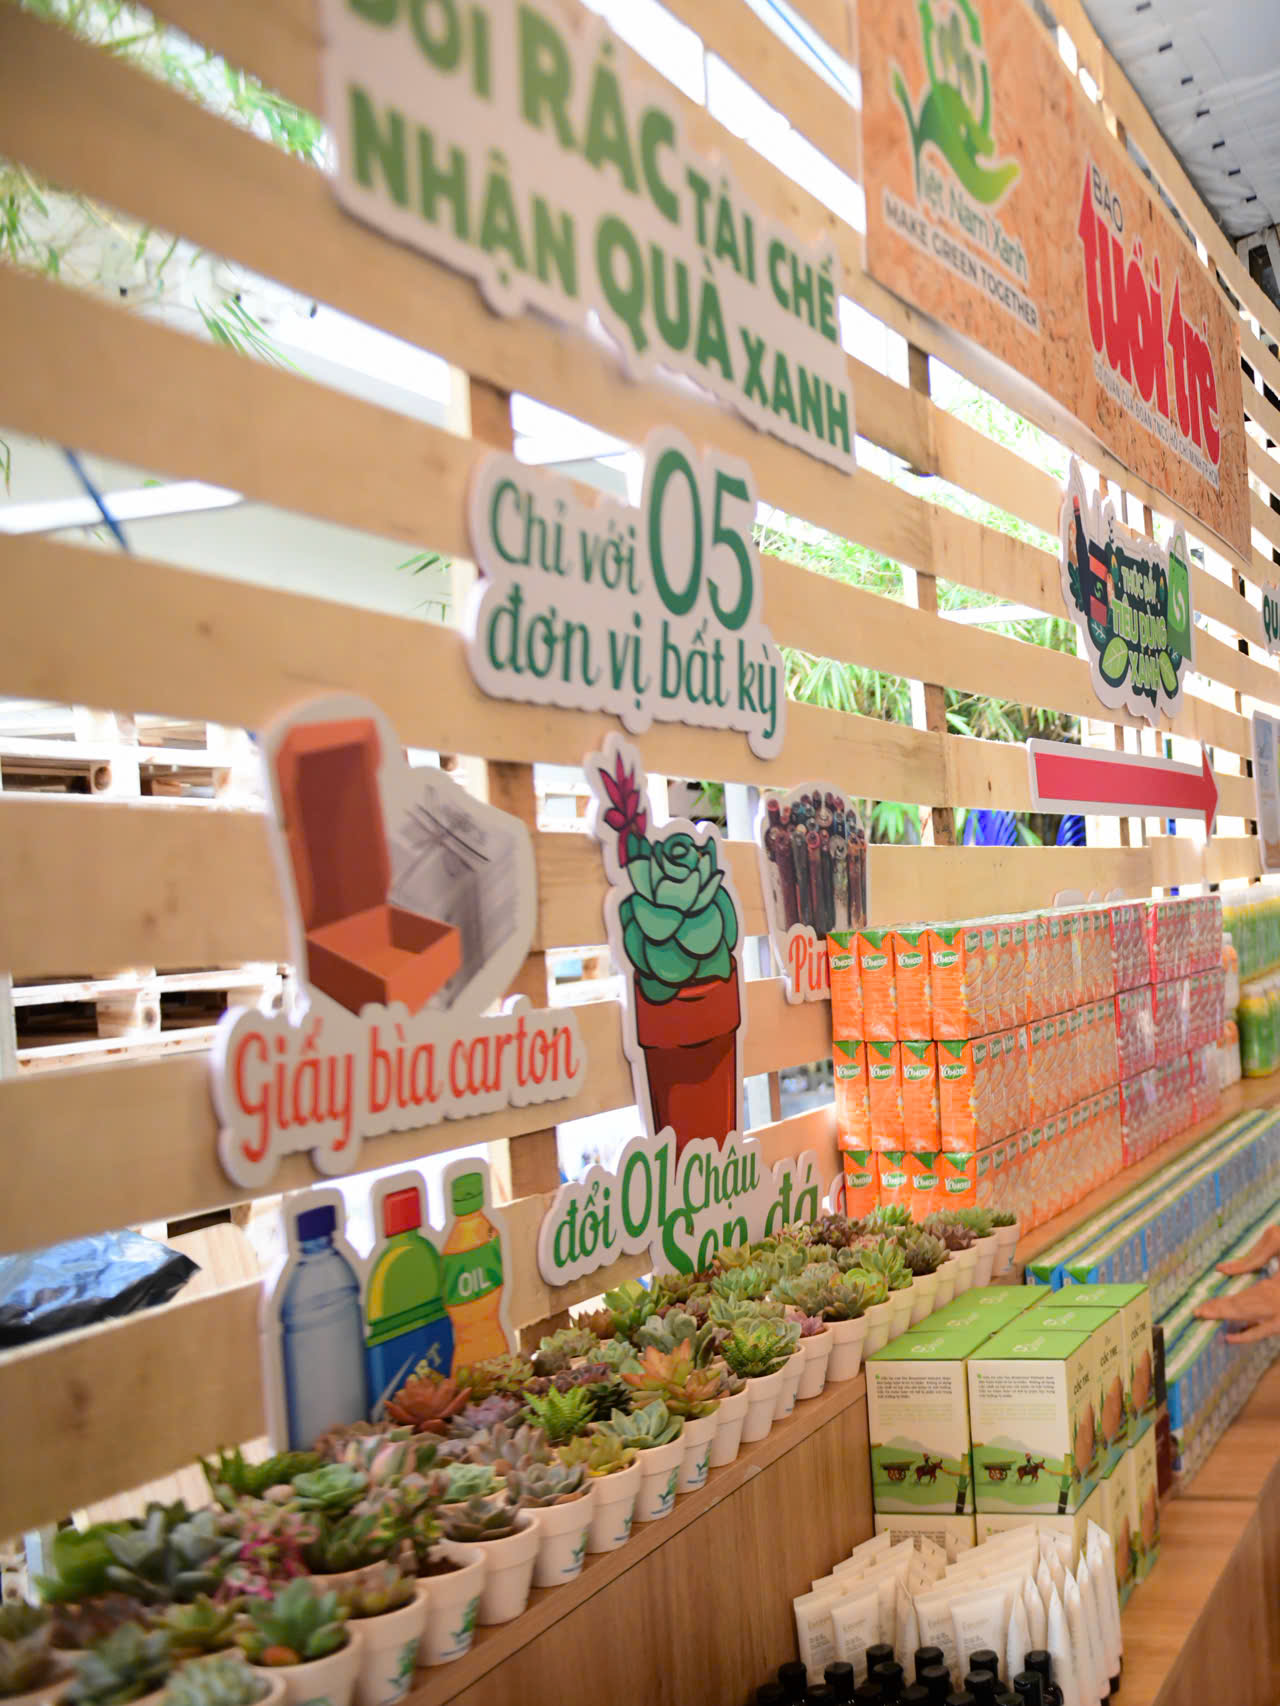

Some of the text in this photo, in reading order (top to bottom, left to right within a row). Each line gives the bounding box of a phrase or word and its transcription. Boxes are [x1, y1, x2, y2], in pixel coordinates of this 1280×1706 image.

[517, 5, 683, 224] RÁC
[687, 165, 756, 285] TÁI
[768, 252, 838, 342] CHẾ
[347, 85, 851, 455] NHẬN QUÀ XANH
[490, 448, 754, 631] Chỉ với 05
[487, 581, 777, 740] đơn vị bất kỳ
[234, 1015, 579, 1163] Giấy bìa carton
[456, 1266, 491, 1297] OIL
[554, 1180, 617, 1268] đổi
[682, 1144, 760, 1216] Chậu
